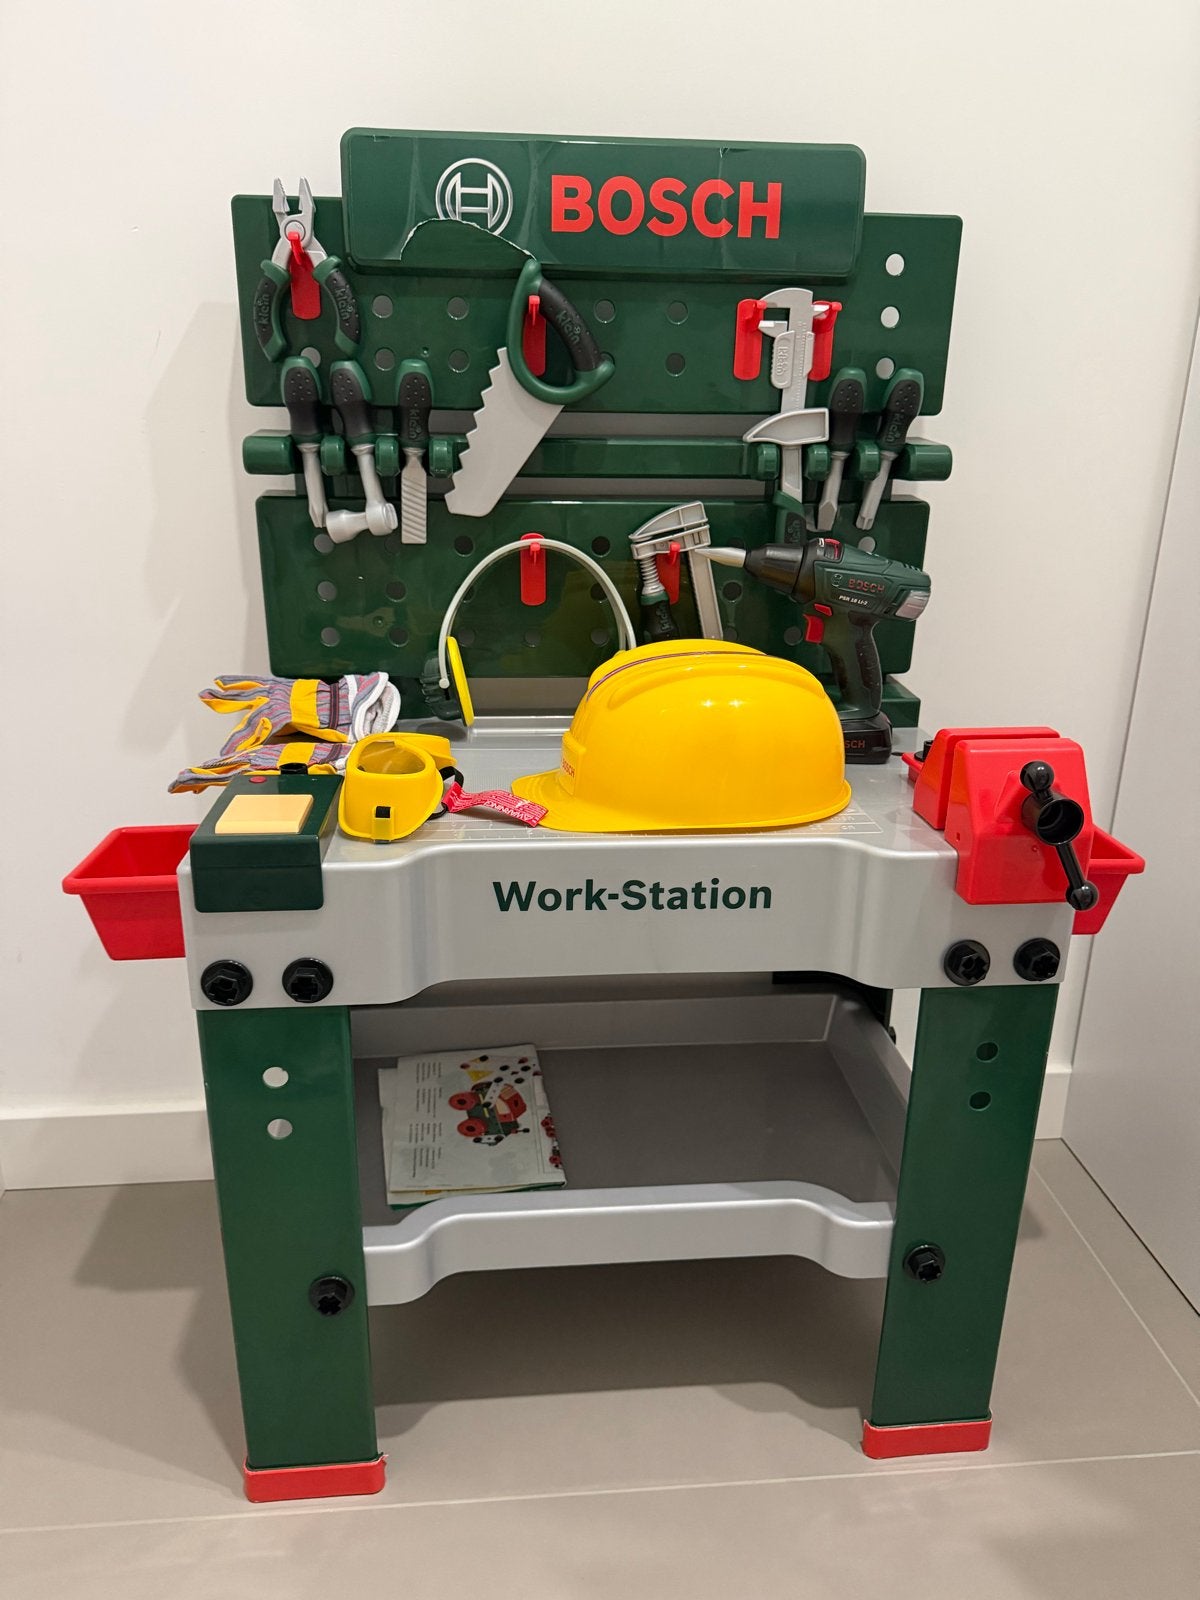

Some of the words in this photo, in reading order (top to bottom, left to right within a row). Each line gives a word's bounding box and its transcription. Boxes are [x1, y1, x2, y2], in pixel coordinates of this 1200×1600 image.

[551, 174, 782, 239] BOSCH
[847, 578, 886, 594] BOSCH
[492, 877, 772, 912] Work-Station
